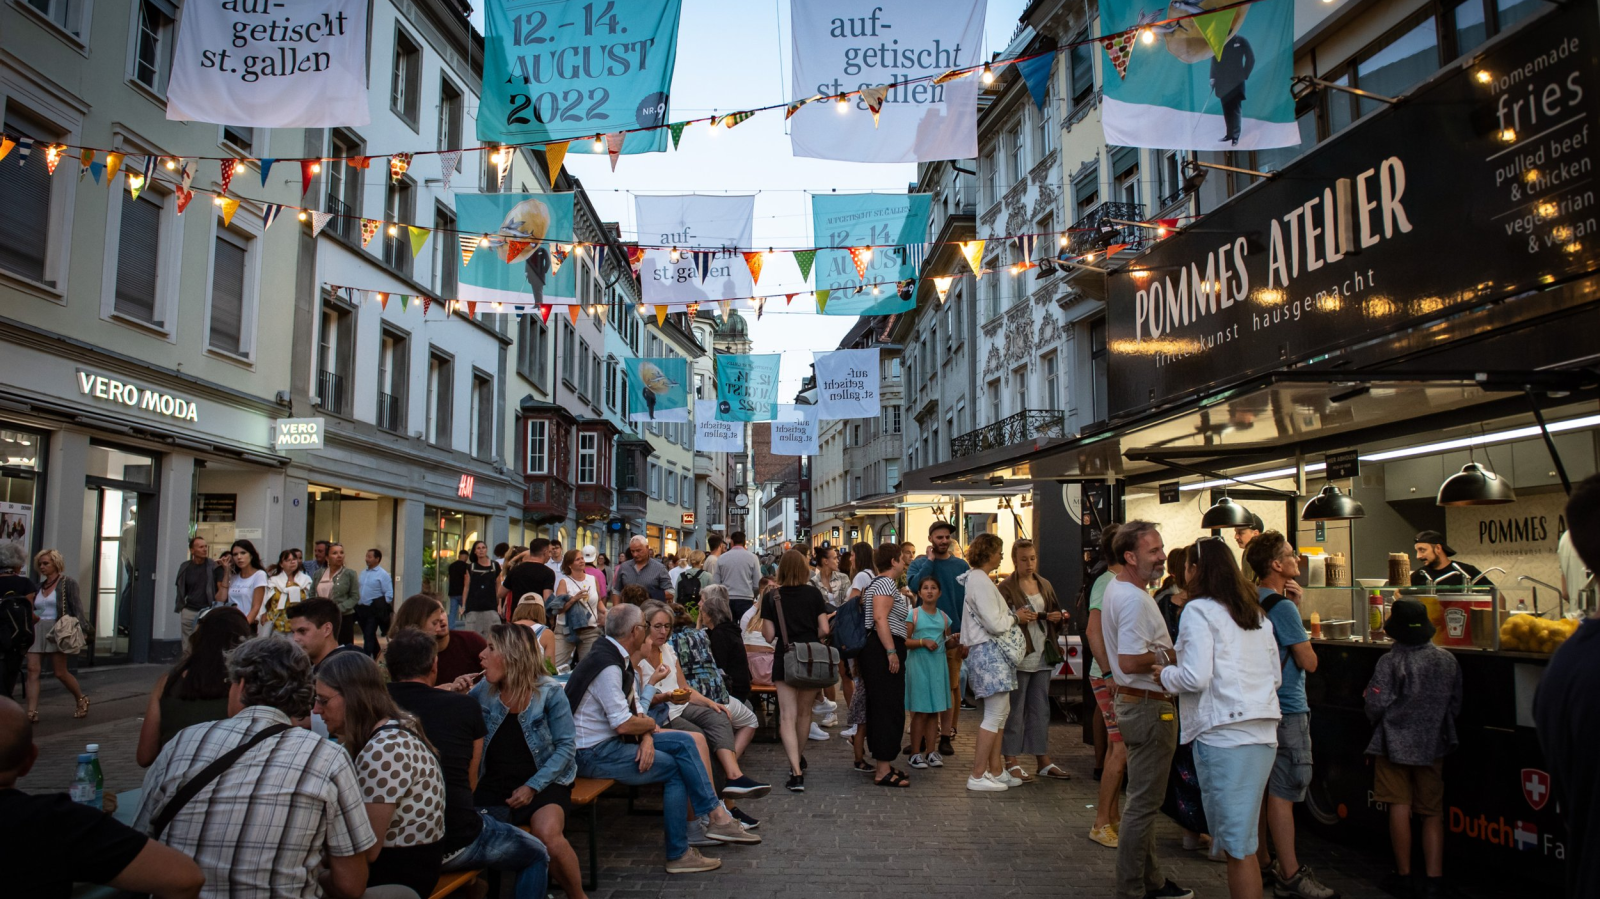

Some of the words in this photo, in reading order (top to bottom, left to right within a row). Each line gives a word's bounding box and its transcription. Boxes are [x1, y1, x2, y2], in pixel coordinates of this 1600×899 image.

[232, 11, 348, 48] getischt
[830, 6, 892, 38] auf-
[505, 37, 655, 85] AUGUST
[843, 39, 962, 76] getischt
[1491, 37, 1579, 96] homemade
[507, 87, 610, 126] 2022
[1496, 71, 1583, 138] fries
[1495, 146, 1545, 187] pulled
[1551, 124, 1589, 159] beef
[1510, 183, 1522, 201] &
[1527, 157, 1591, 195] chicken
[1505, 191, 1595, 236] vegearian
[660, 226, 698, 245] auf-
[1135, 236, 1250, 344] POMMES
[1268, 156, 1413, 290] ATELIER
[1528, 235, 1540, 254] &
[653, 265, 732, 284] st.gaen
[826, 246, 907, 278] AUUST
[1253, 268, 1376, 331] hausgemacht
[77, 372, 138, 406] VERO
[141, 390, 199, 423] MODA
[277, 434, 319, 445] MODA
[281, 423, 318, 435] VERO
[1479, 516, 1548, 545] POMMES
